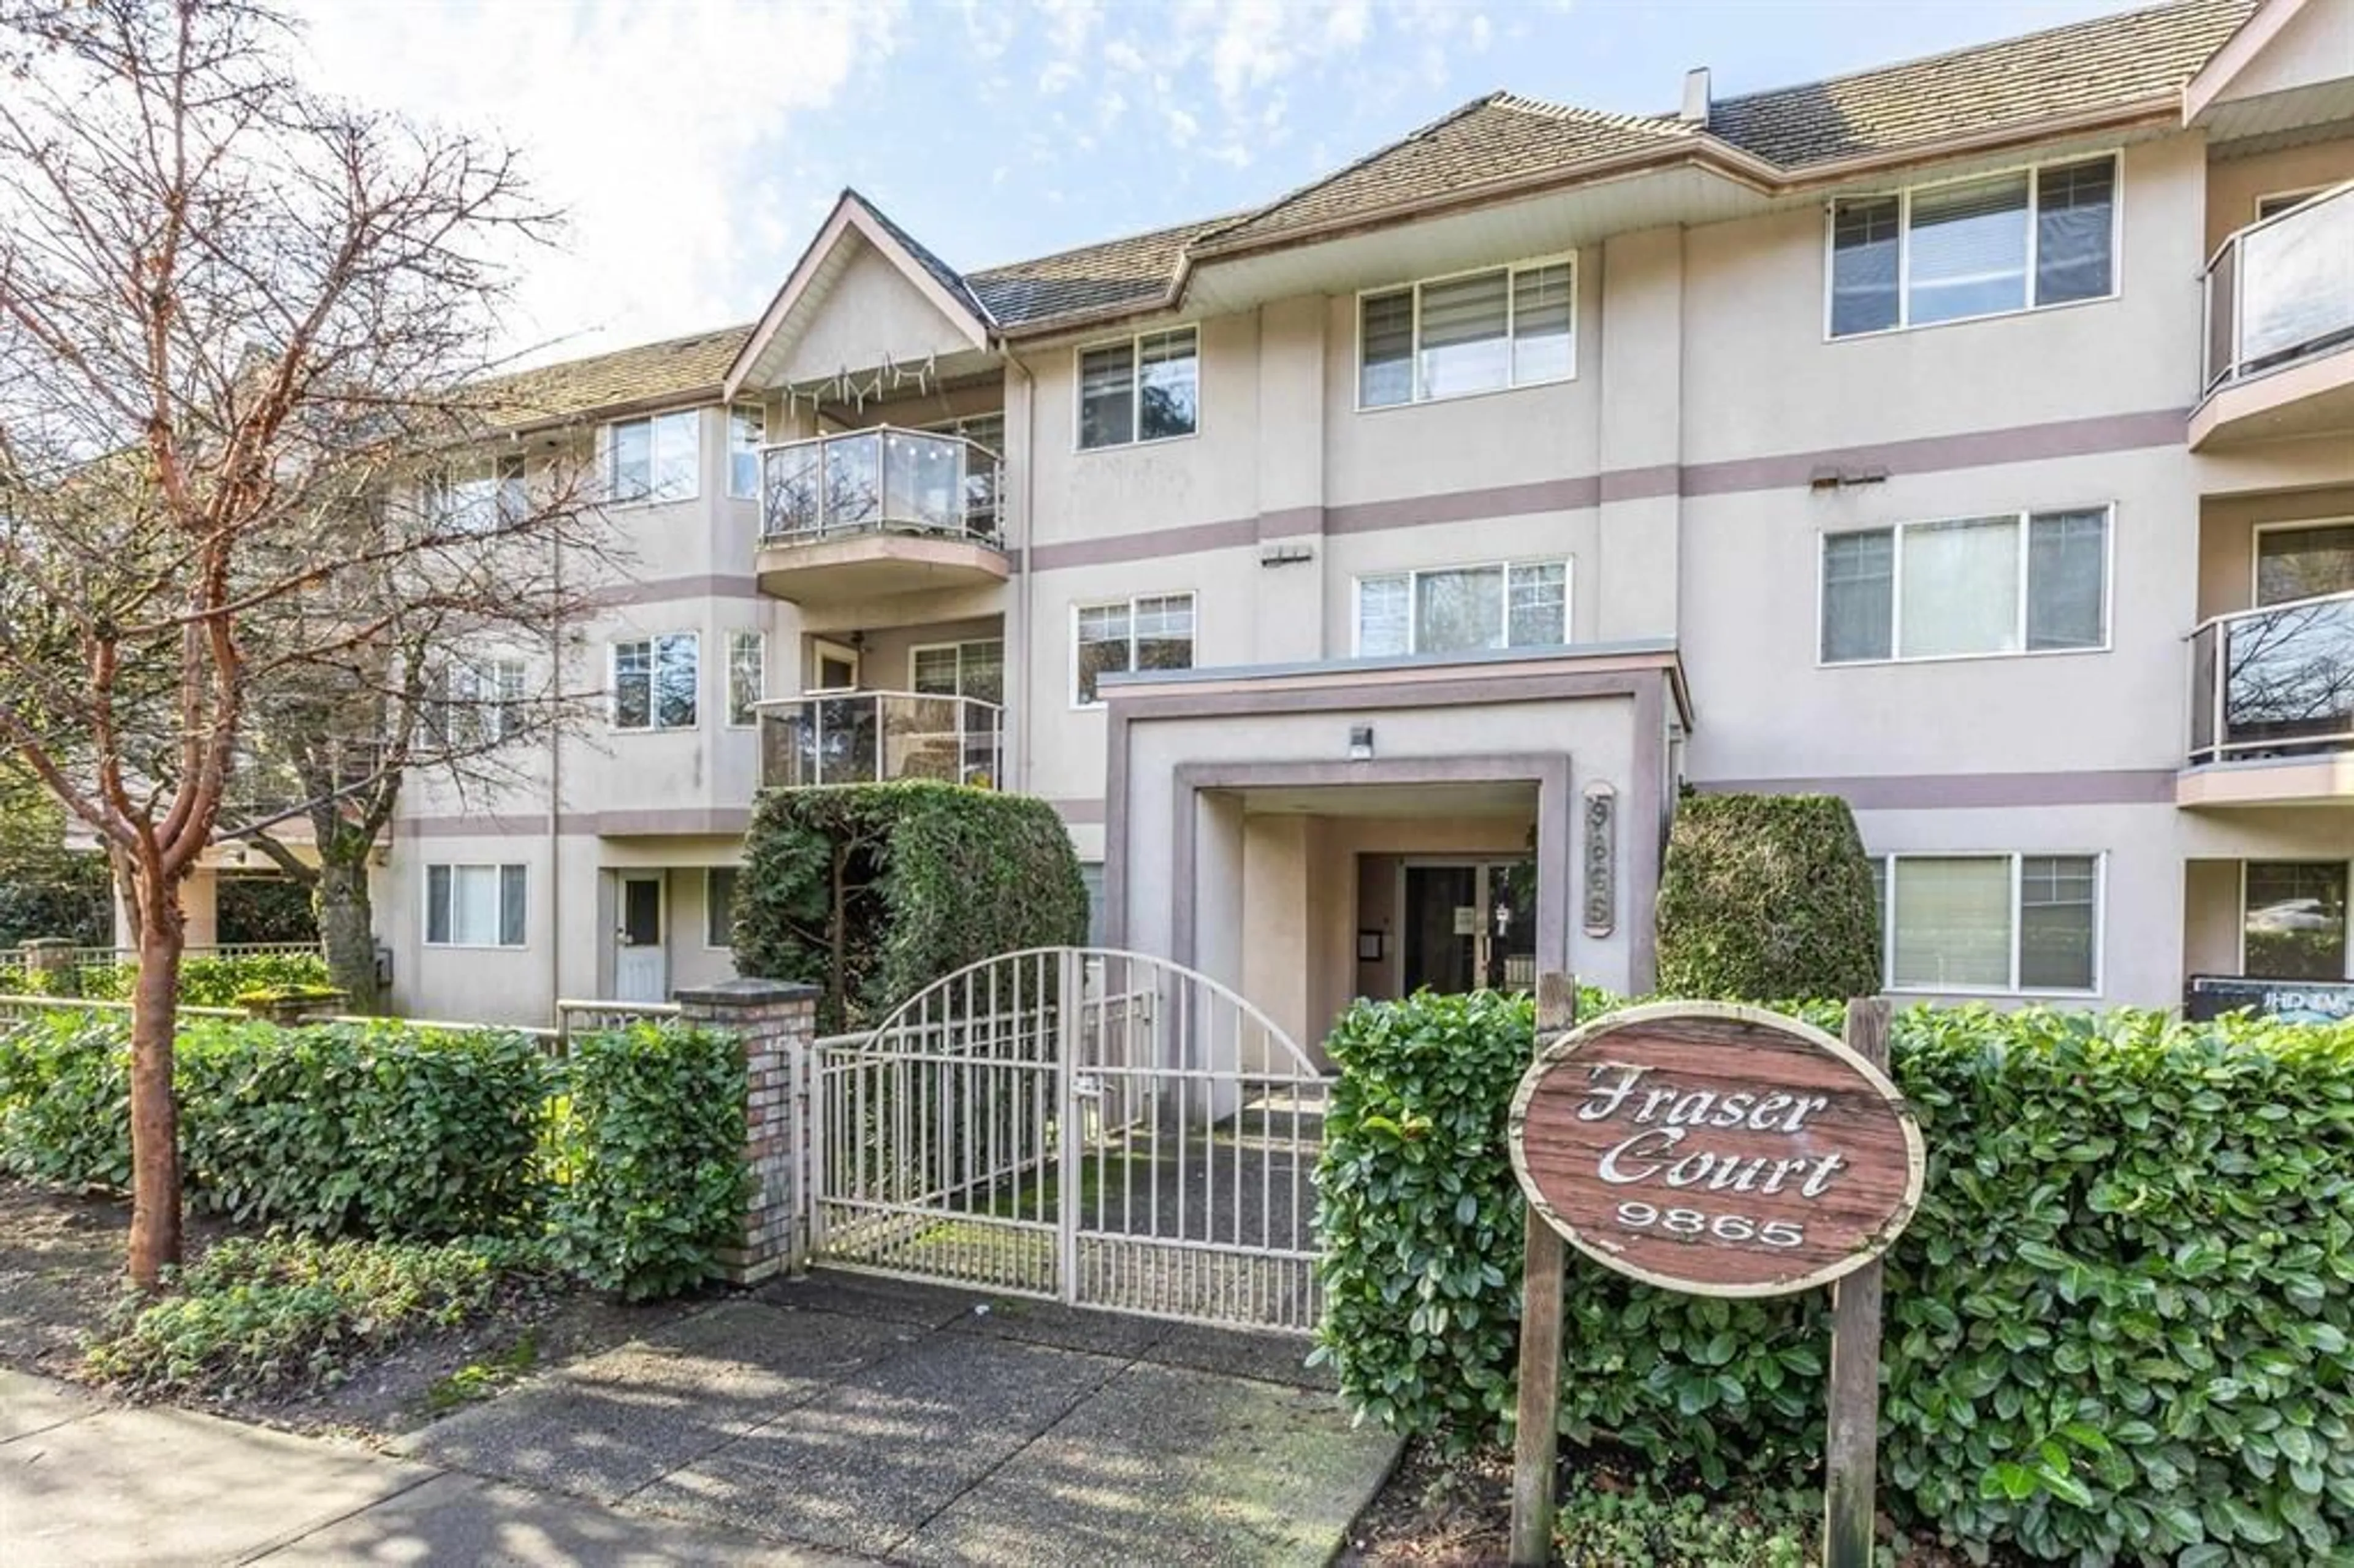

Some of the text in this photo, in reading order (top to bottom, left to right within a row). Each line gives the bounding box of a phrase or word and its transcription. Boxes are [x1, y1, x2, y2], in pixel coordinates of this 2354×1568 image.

[1577, 1061, 1829, 1133] Fraser
[1598, 1127, 1846, 1197] Court
[1616, 1201, 1804, 1247] 9865
